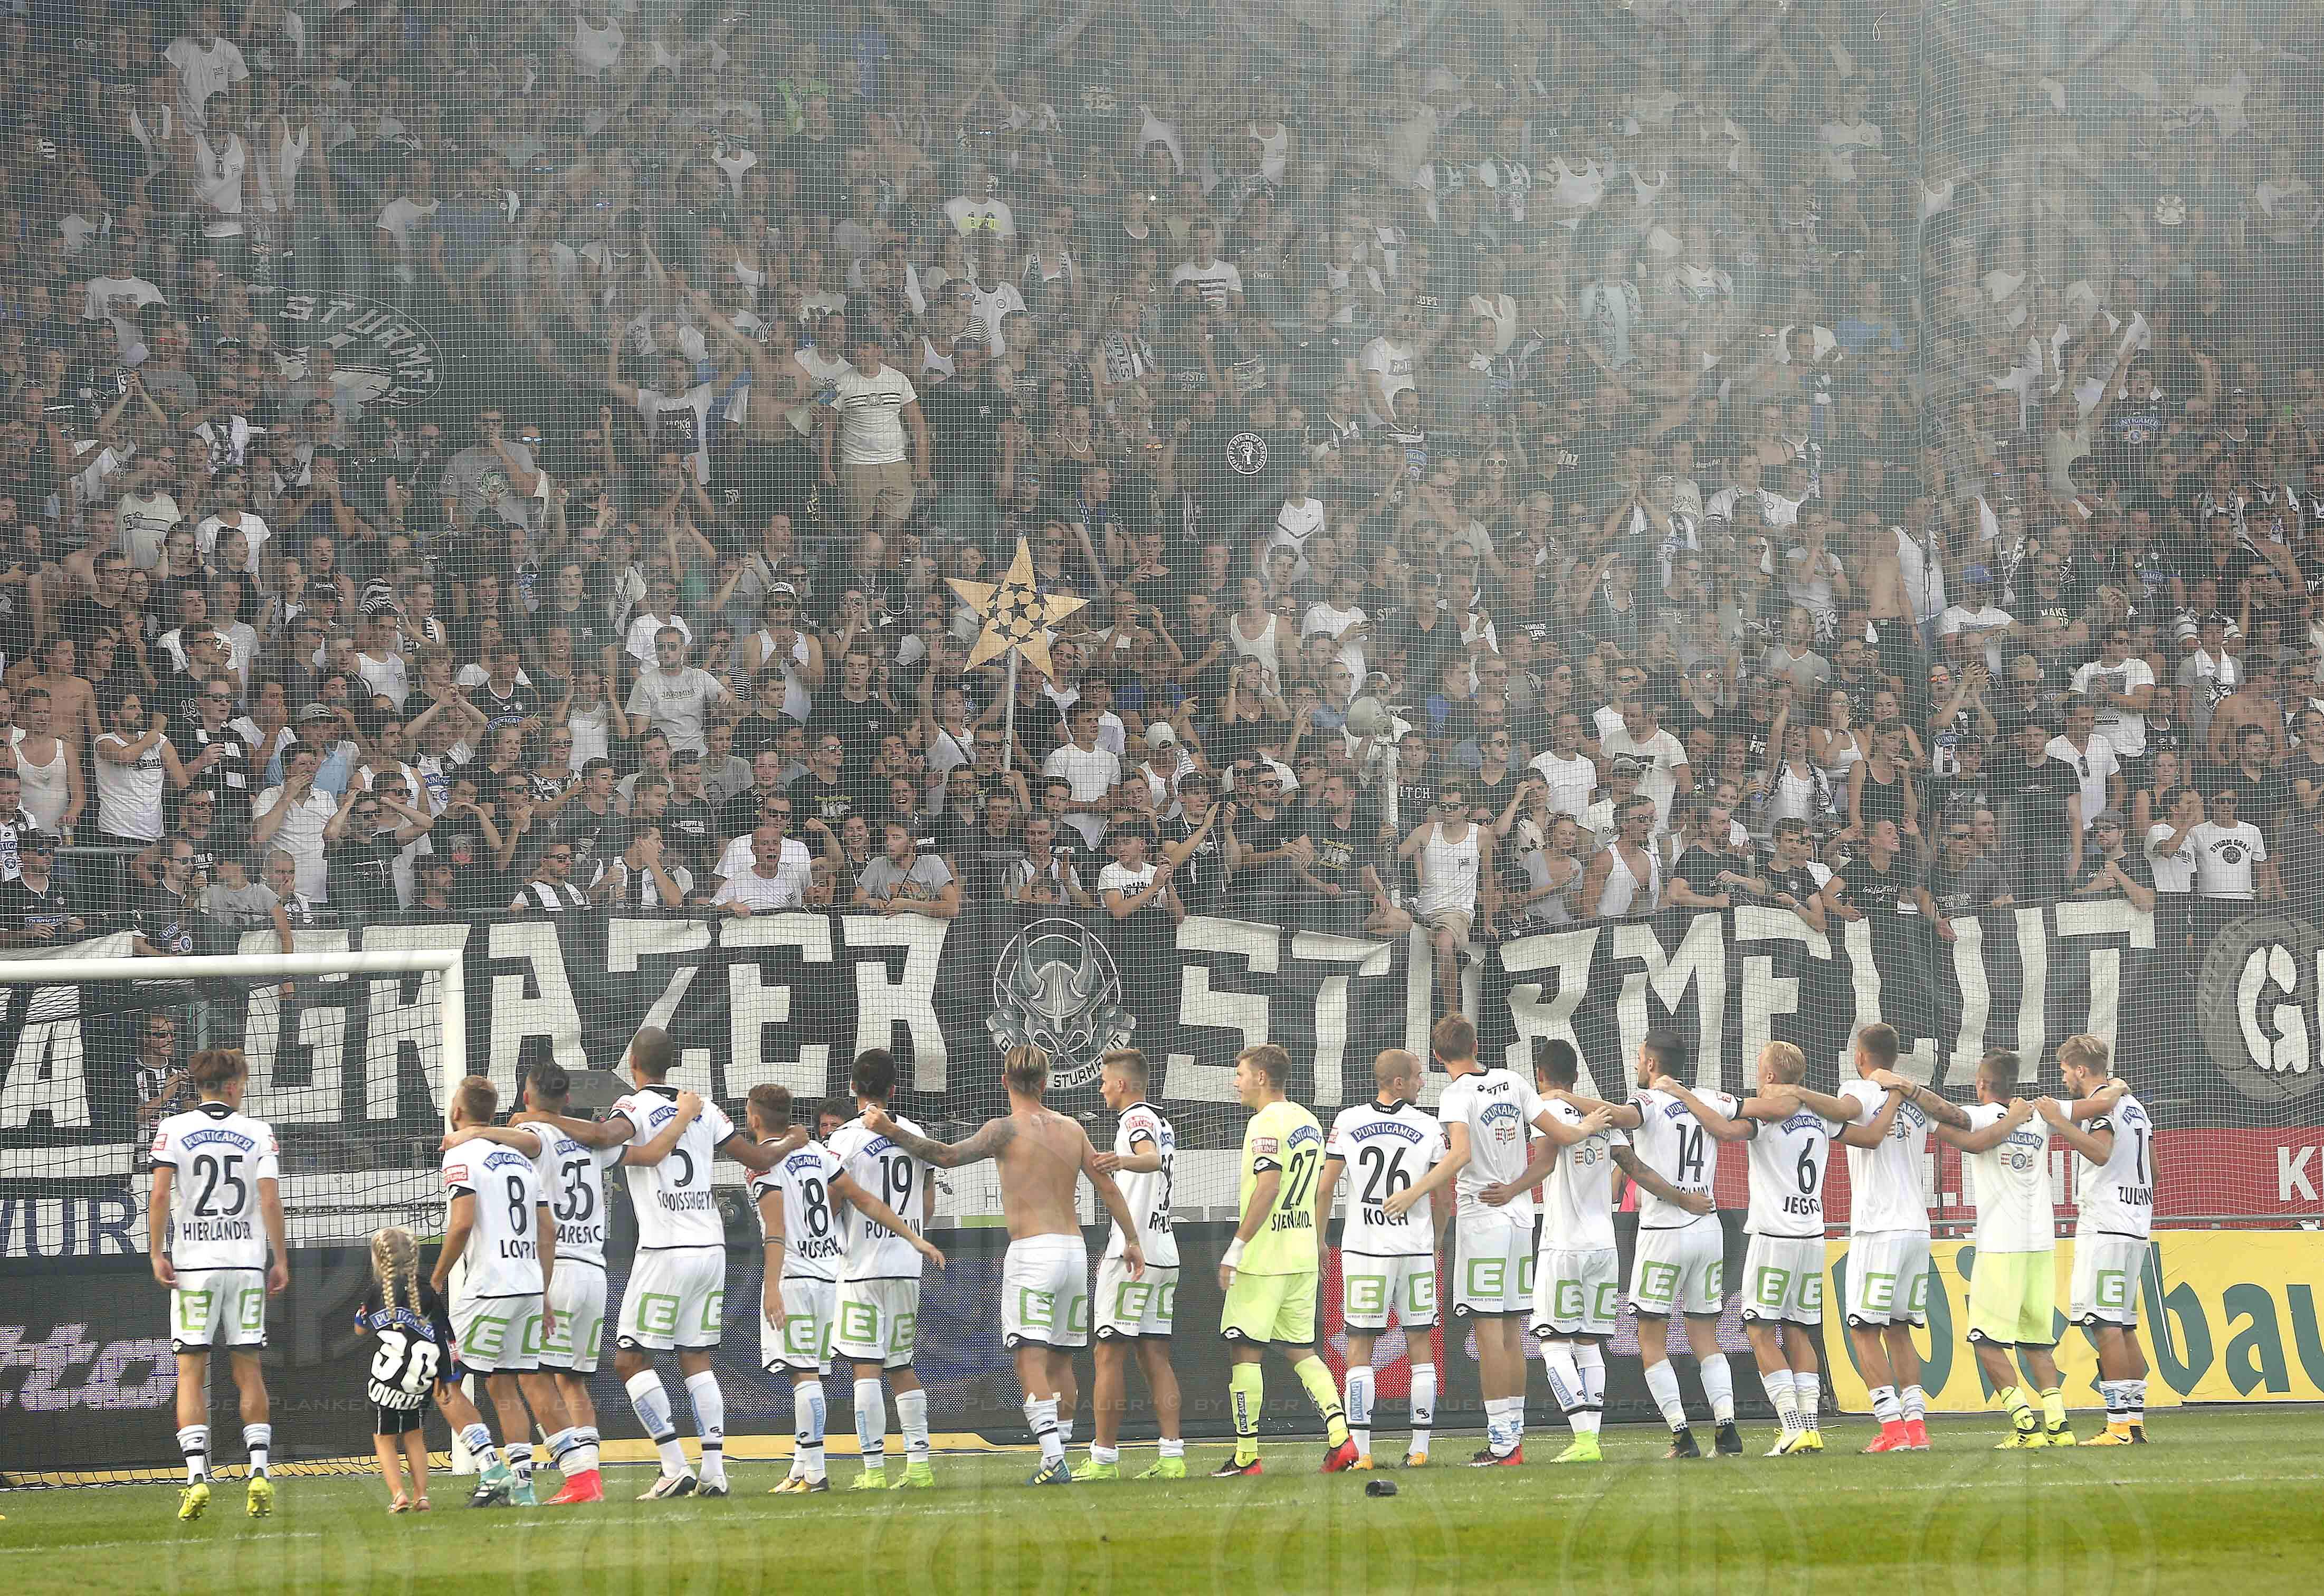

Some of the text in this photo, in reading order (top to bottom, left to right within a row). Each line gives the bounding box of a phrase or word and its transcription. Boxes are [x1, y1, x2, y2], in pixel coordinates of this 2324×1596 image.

[235, 913, 950, 1123] GRAZER
[0, 984, 91, 1128] A
[183, 1132, 254, 1152] PUNTIGAMER
[1353, 1123, 1422, 1143] PUNTIGAMER
[1677, 1123, 1703, 1182] 14
[193, 1155, 246, 1217] 25
[554, 1160, 592, 1222] 35
[879, 1155, 913, 1216] 19
[1281, 1149, 1318, 1210] 27
[1359, 1146, 1411, 1205] 26
[1797, 1138, 1816, 1195] 6
[507, 1175, 527, 1237] 8
[371, 1329, 441, 1394] 30
